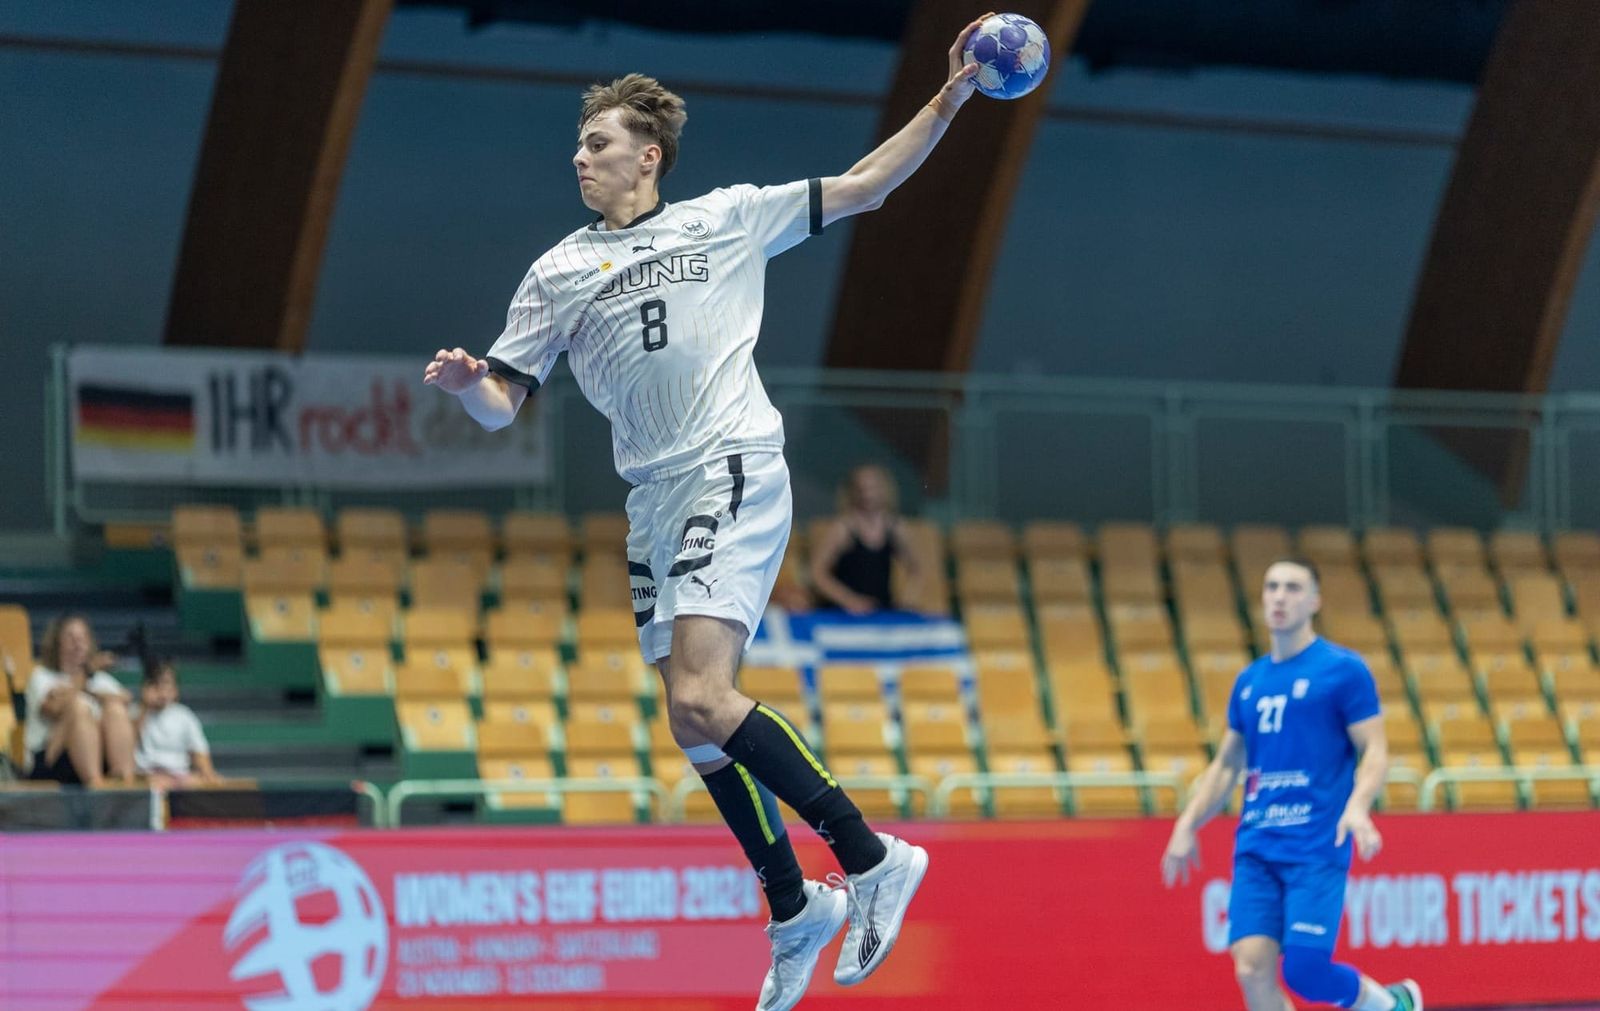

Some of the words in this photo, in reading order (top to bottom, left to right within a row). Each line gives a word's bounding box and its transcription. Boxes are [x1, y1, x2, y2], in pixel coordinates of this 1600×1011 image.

[596, 253, 709, 301] JUNG
[640, 298, 668, 353] 8
[208, 366, 294, 457] IHR
[680, 536, 716, 551] TING
[631, 585, 658, 600] TING
[1256, 694, 1288, 734] 27
[601, 868, 677, 922] EURO
[1347, 874, 1448, 949] YOUR
[1453, 869, 1600, 944] TICKETS
